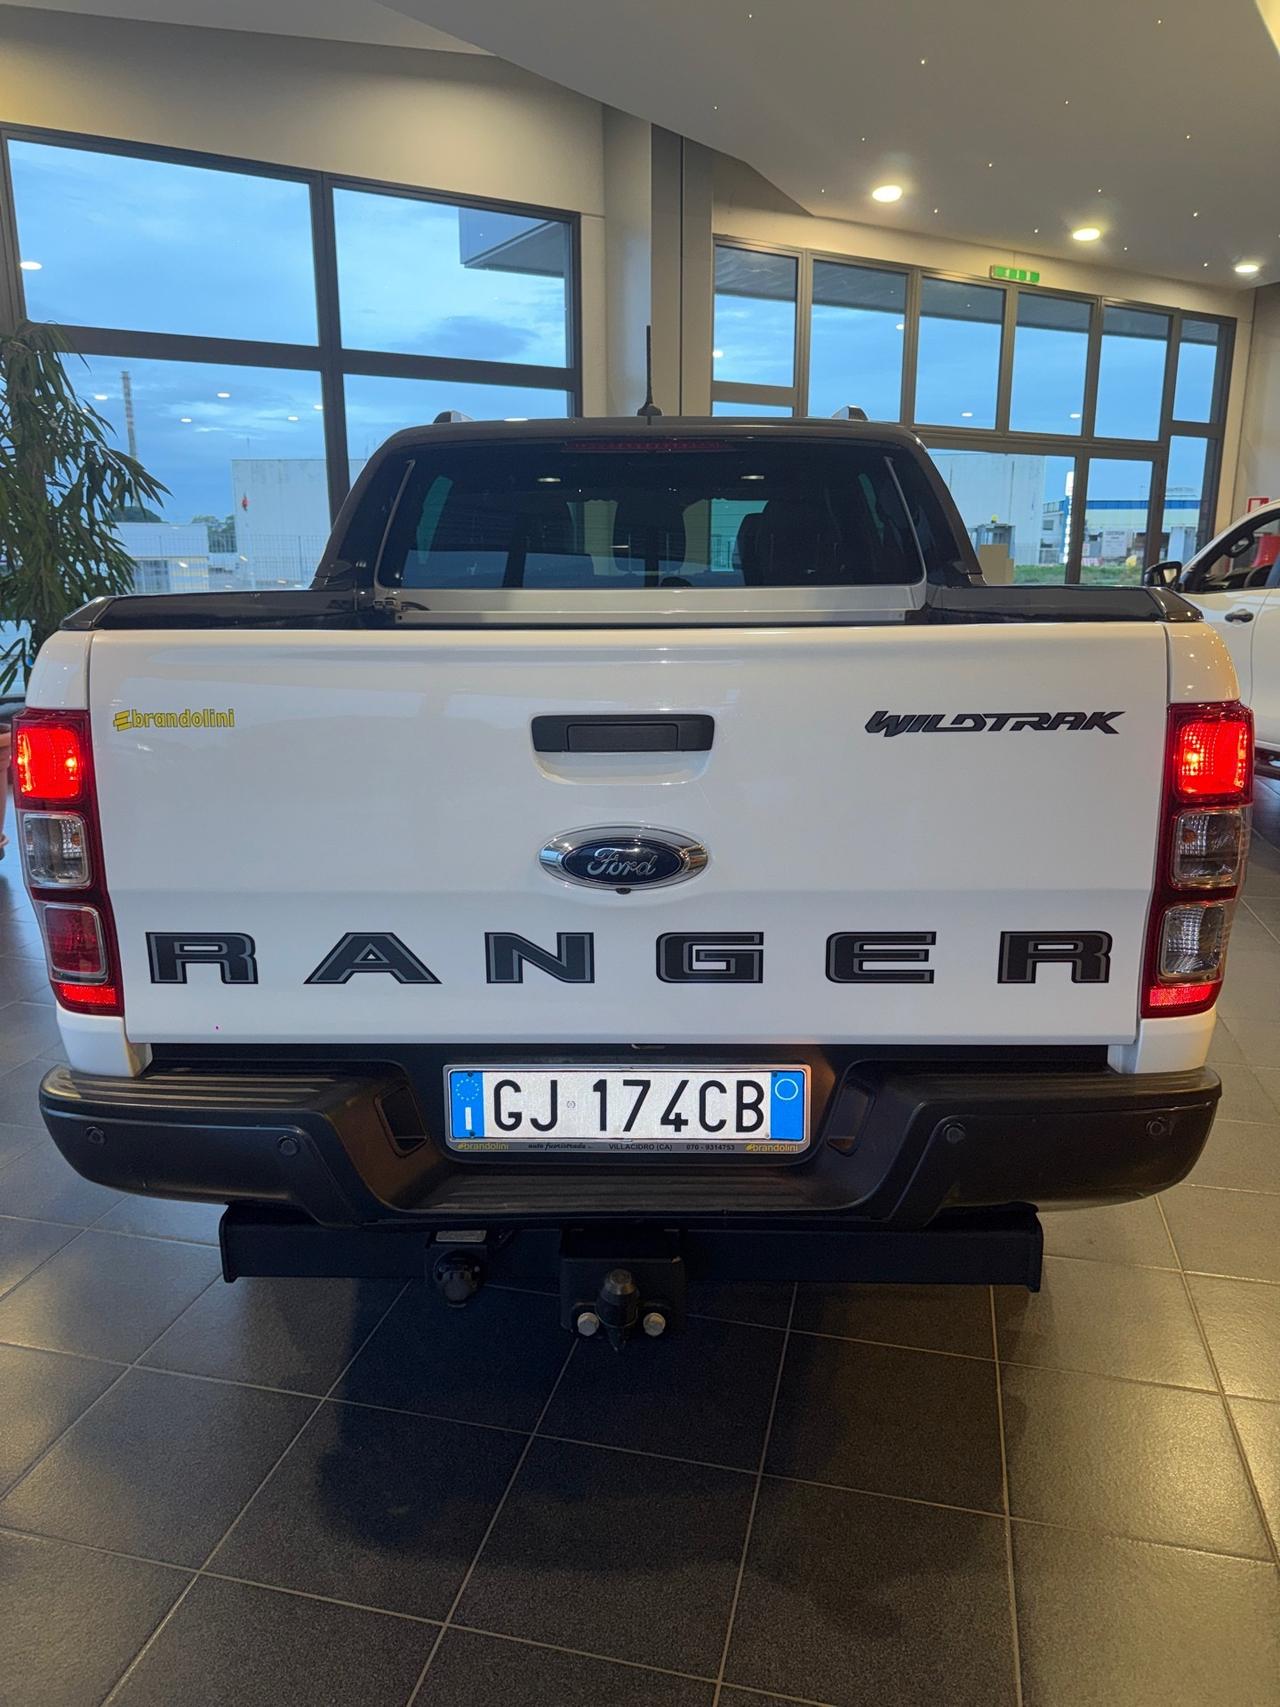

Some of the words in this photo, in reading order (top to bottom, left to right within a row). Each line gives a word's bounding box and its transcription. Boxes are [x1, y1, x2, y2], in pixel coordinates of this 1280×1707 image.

[130, 708, 235, 728] brandolini
[865, 710, 1126, 737] WILDTRAK
[587, 847, 658, 876] Ford
[145, 930, 1113, 984] RANGER
[493, 1079, 558, 1132] GJ
[592, 1079, 765, 1132] 174CB
[656, 1143, 673, 1151] (CA)
